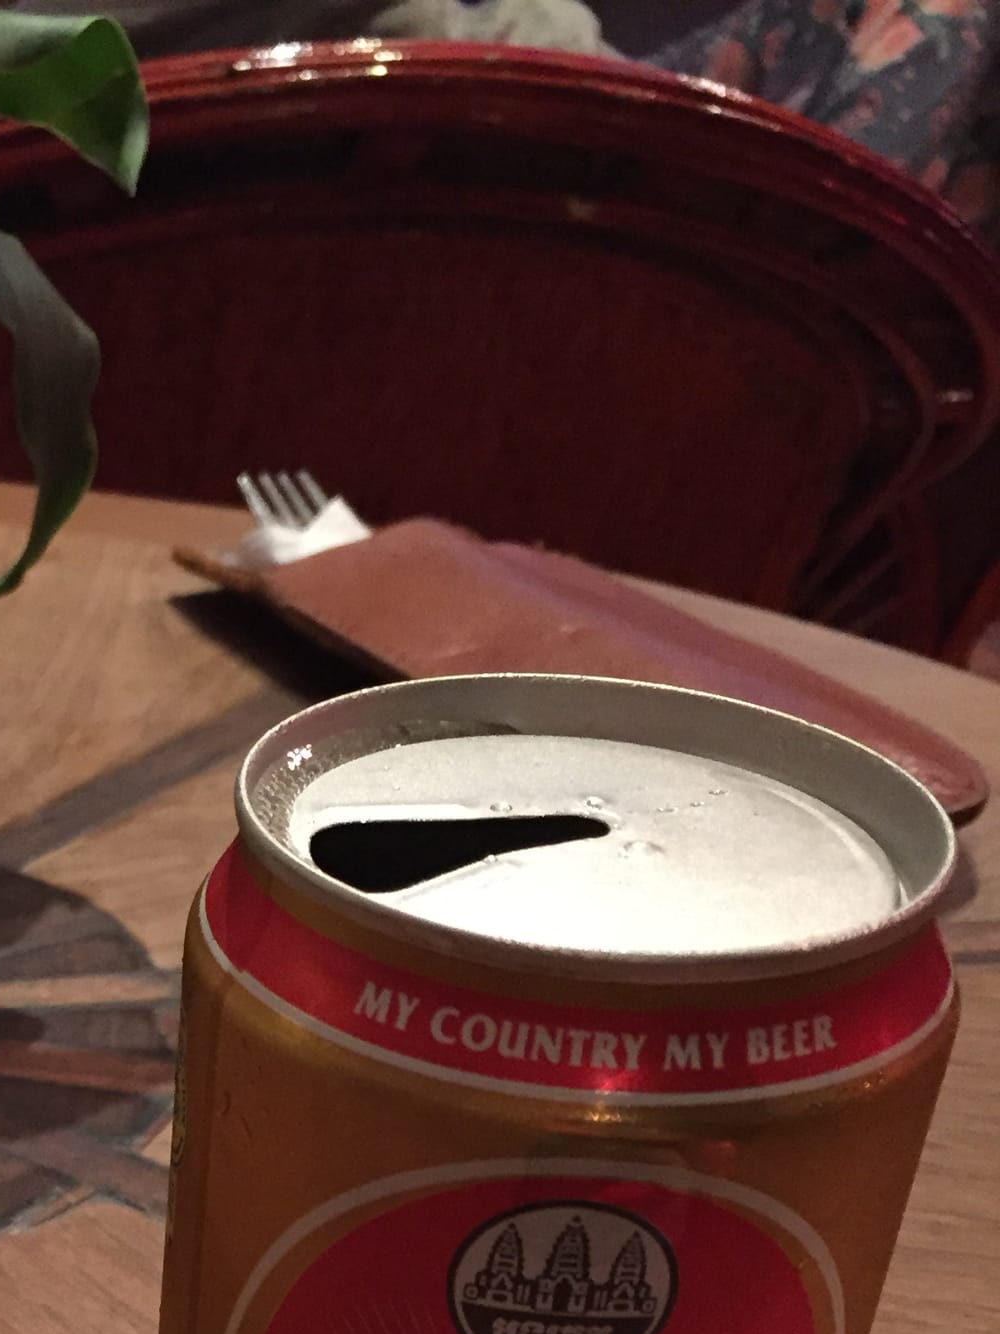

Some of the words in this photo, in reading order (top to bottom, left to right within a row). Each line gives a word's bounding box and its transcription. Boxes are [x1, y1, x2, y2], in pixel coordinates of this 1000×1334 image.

[353, 982, 419, 1031] MY
[429, 1007, 647, 1070] COUNTRY
[663, 1032, 730, 1071] MY
[746, 1015, 836, 1065] BEER
